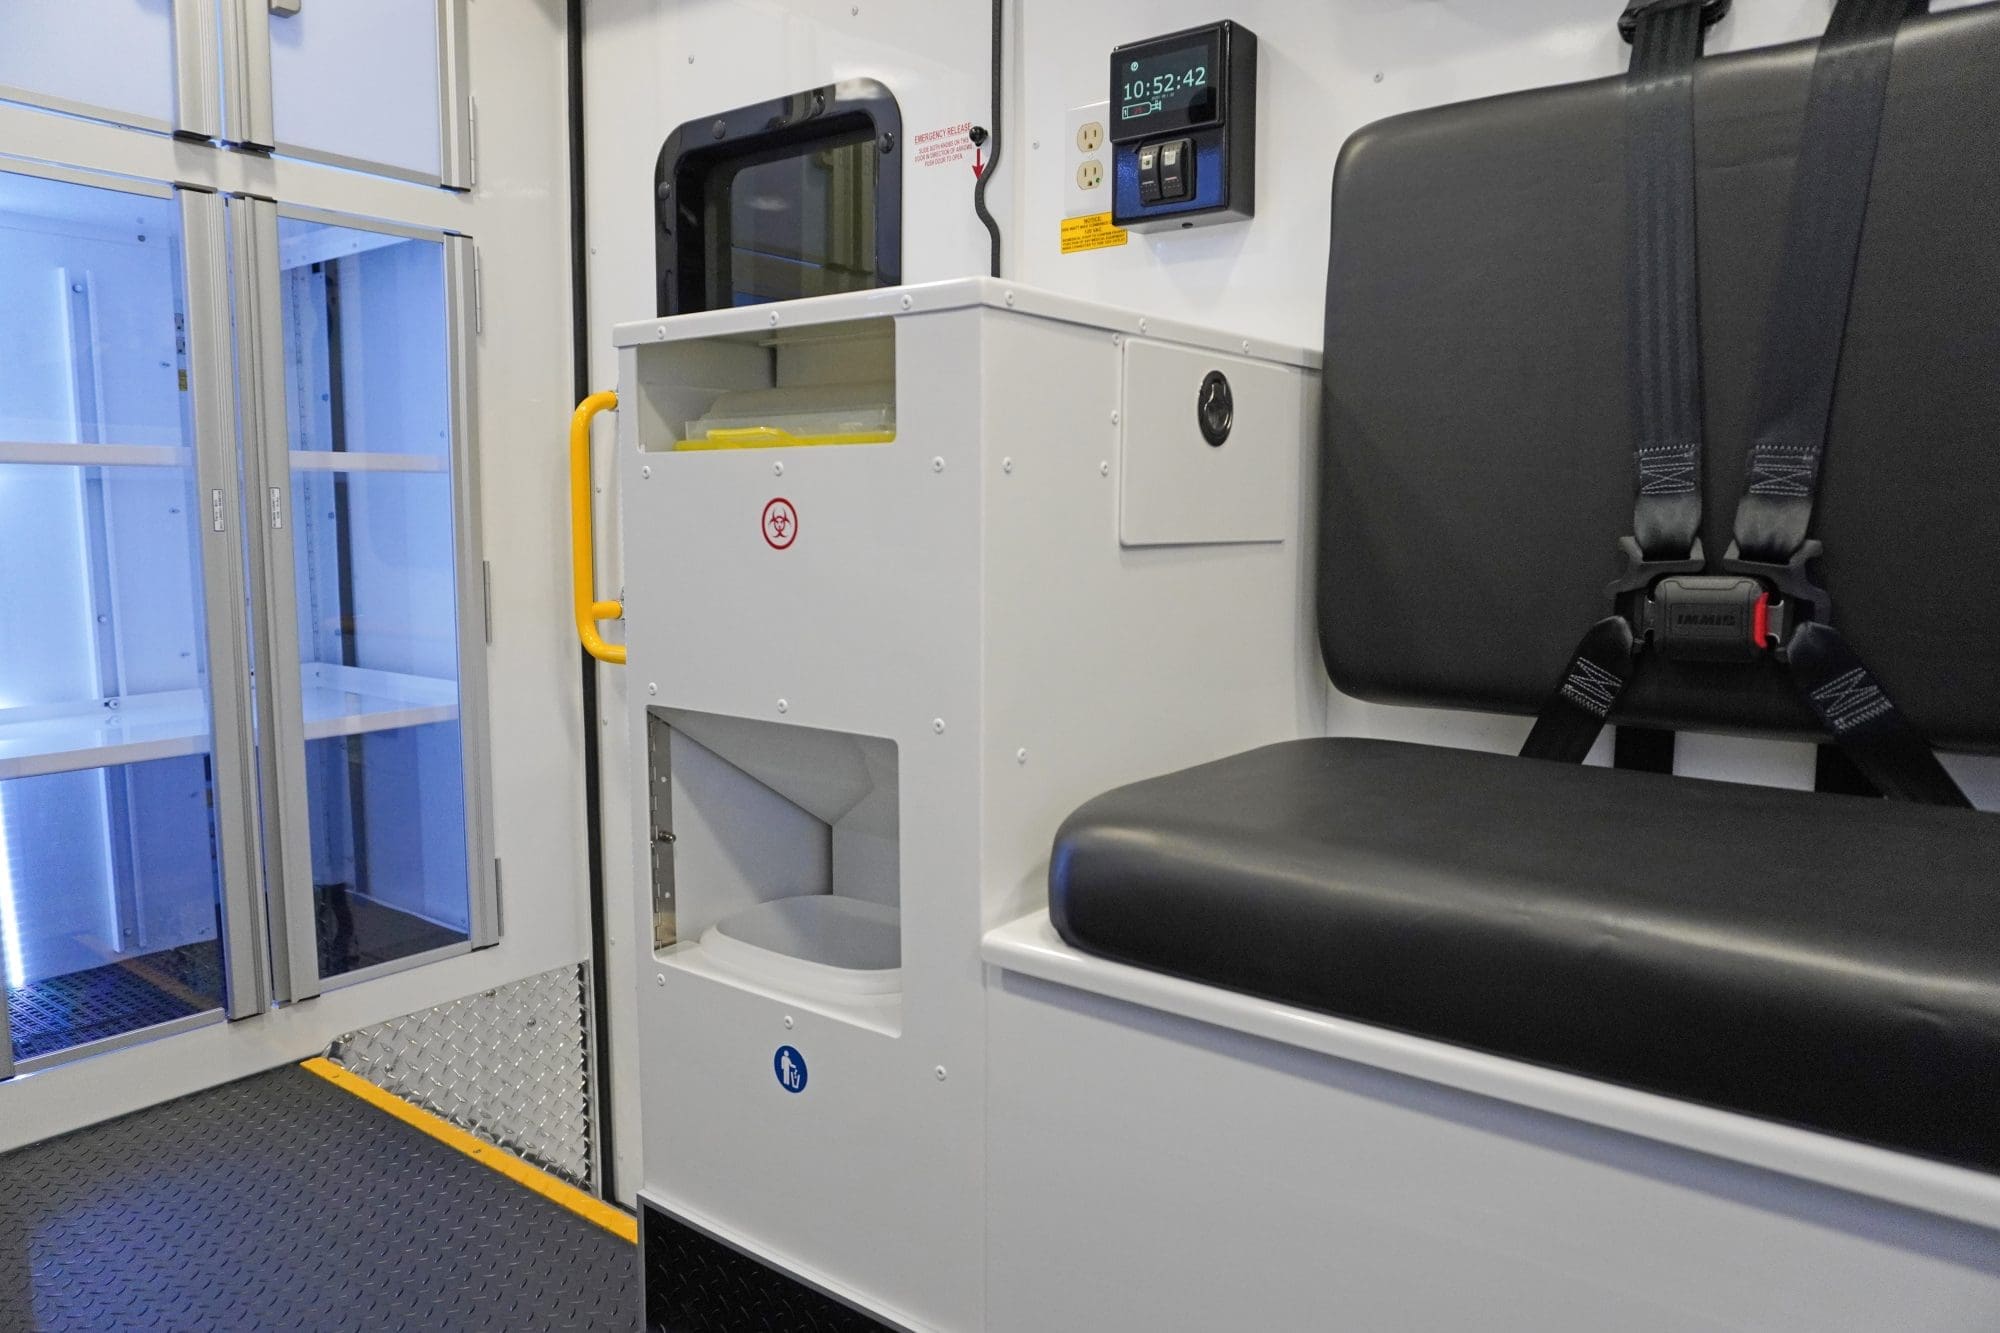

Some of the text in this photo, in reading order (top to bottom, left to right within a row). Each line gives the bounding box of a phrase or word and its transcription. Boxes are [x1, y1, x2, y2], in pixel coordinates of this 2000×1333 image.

[1124, 67, 1206, 101] 10:52:42
[914, 122, 972, 144] EMERGENCY RELEASE
